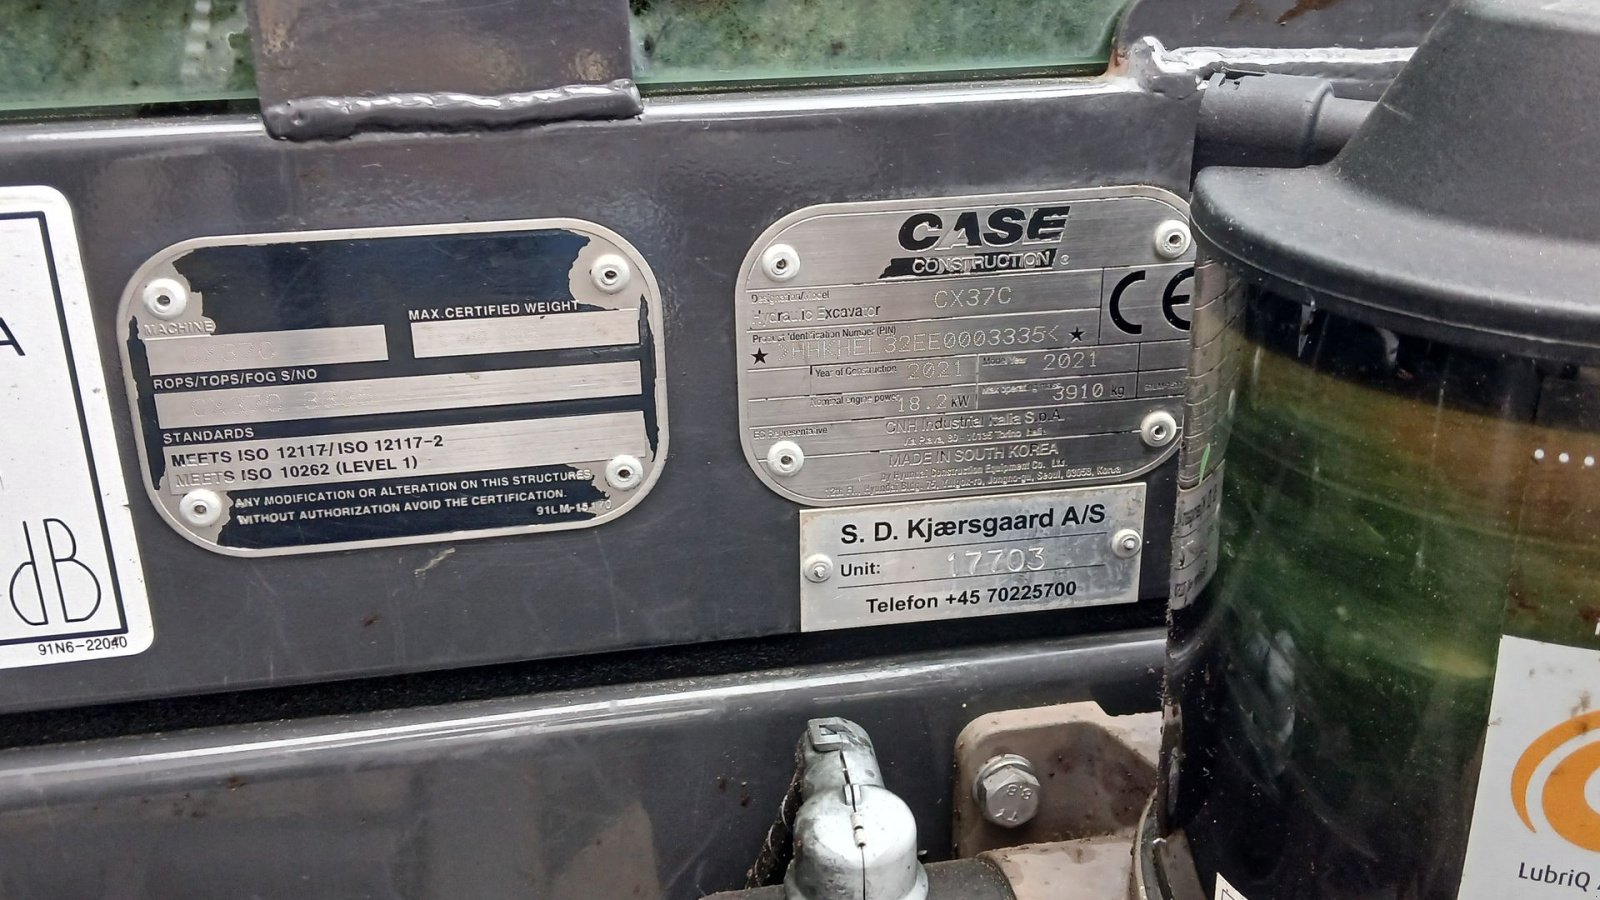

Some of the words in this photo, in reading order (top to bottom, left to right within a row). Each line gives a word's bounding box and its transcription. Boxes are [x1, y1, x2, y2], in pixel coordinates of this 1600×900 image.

[898, 206, 1070, 251] CASE
[912, 251, 1050, 274] CONSTRUCTION
[525, 300, 579, 314] WEIGHT
[934, 287, 1011, 308] CX37C
[817, 305, 880, 321] Excavator
[144, 320, 216, 336] MACHINE
[843, 326, 874, 338] Number
[877, 325, 896, 337] (PIN)
[907, 360, 962, 381] 2021
[1043, 351, 1097, 371] 2021
[153, 370, 276, 390] ROPS/TOPS/FOG
[281, 368, 317, 382] S/NO
[815, 369, 833, 379] Year
[835, 368, 844, 377] of
[845, 365, 897, 377] Construction
[1052, 383, 1104, 401] 3910
[1111, 384, 1125, 398] kg
[899, 394, 947, 412] 18.2
[951, 396, 969, 408] kW
[162, 427, 254, 444] STANDARDS
[885, 421, 917, 435] CNH
[921, 415, 984, 433] Industrial
[171, 450, 232, 468] MEETS
[238, 448, 268, 462] ISO
[374, 435, 443, 451] 12117-2
[889, 453, 932, 468] MADE
[936, 450, 950, 464] IN
[955, 447, 1005, 463] SOUTH
[1008, 443, 1059, 459] KOREA
[175, 470, 235, 488] MEETS
[242, 466, 272, 481] ISO
[280, 463, 330, 478] 10262
[336, 458, 397, 475] (LEVEL
[402, 456, 418, 470] 1)
[234, 496, 261, 509] ANY
[263, 490, 355, 506] MODIFICATION
[359, 486, 376, 499] OR
[380, 481, 457, 498] ALTERATION
[461, 479, 478, 491] ON
[481, 476, 509, 489] THIS
[236, 511, 295, 526] WITHOUT
[299, 503, 400, 521] AUTHORIZATION
[404, 499, 441, 511] AVOID
[445, 496, 468, 508] THE
[471, 489, 567, 505] CERTIFICATION.
[841, 523, 865, 545] S.
[874, 521, 898, 542] D.
[907, 507, 1054, 543] Kjærsgaard
[1061, 504, 1105, 526] A/S
[9, 518, 101, 626] dB
[840, 562, 881, 577] Unit:
[947, 547, 1046, 577] 17703
[866, 595, 938, 614] Telefon
[945, 589, 980, 606] +45
[987, 581, 1077, 603] 70225700
[38, 636, 127, 656] 91N6-22040
[1519, 862, 1590, 892] LubriQ
